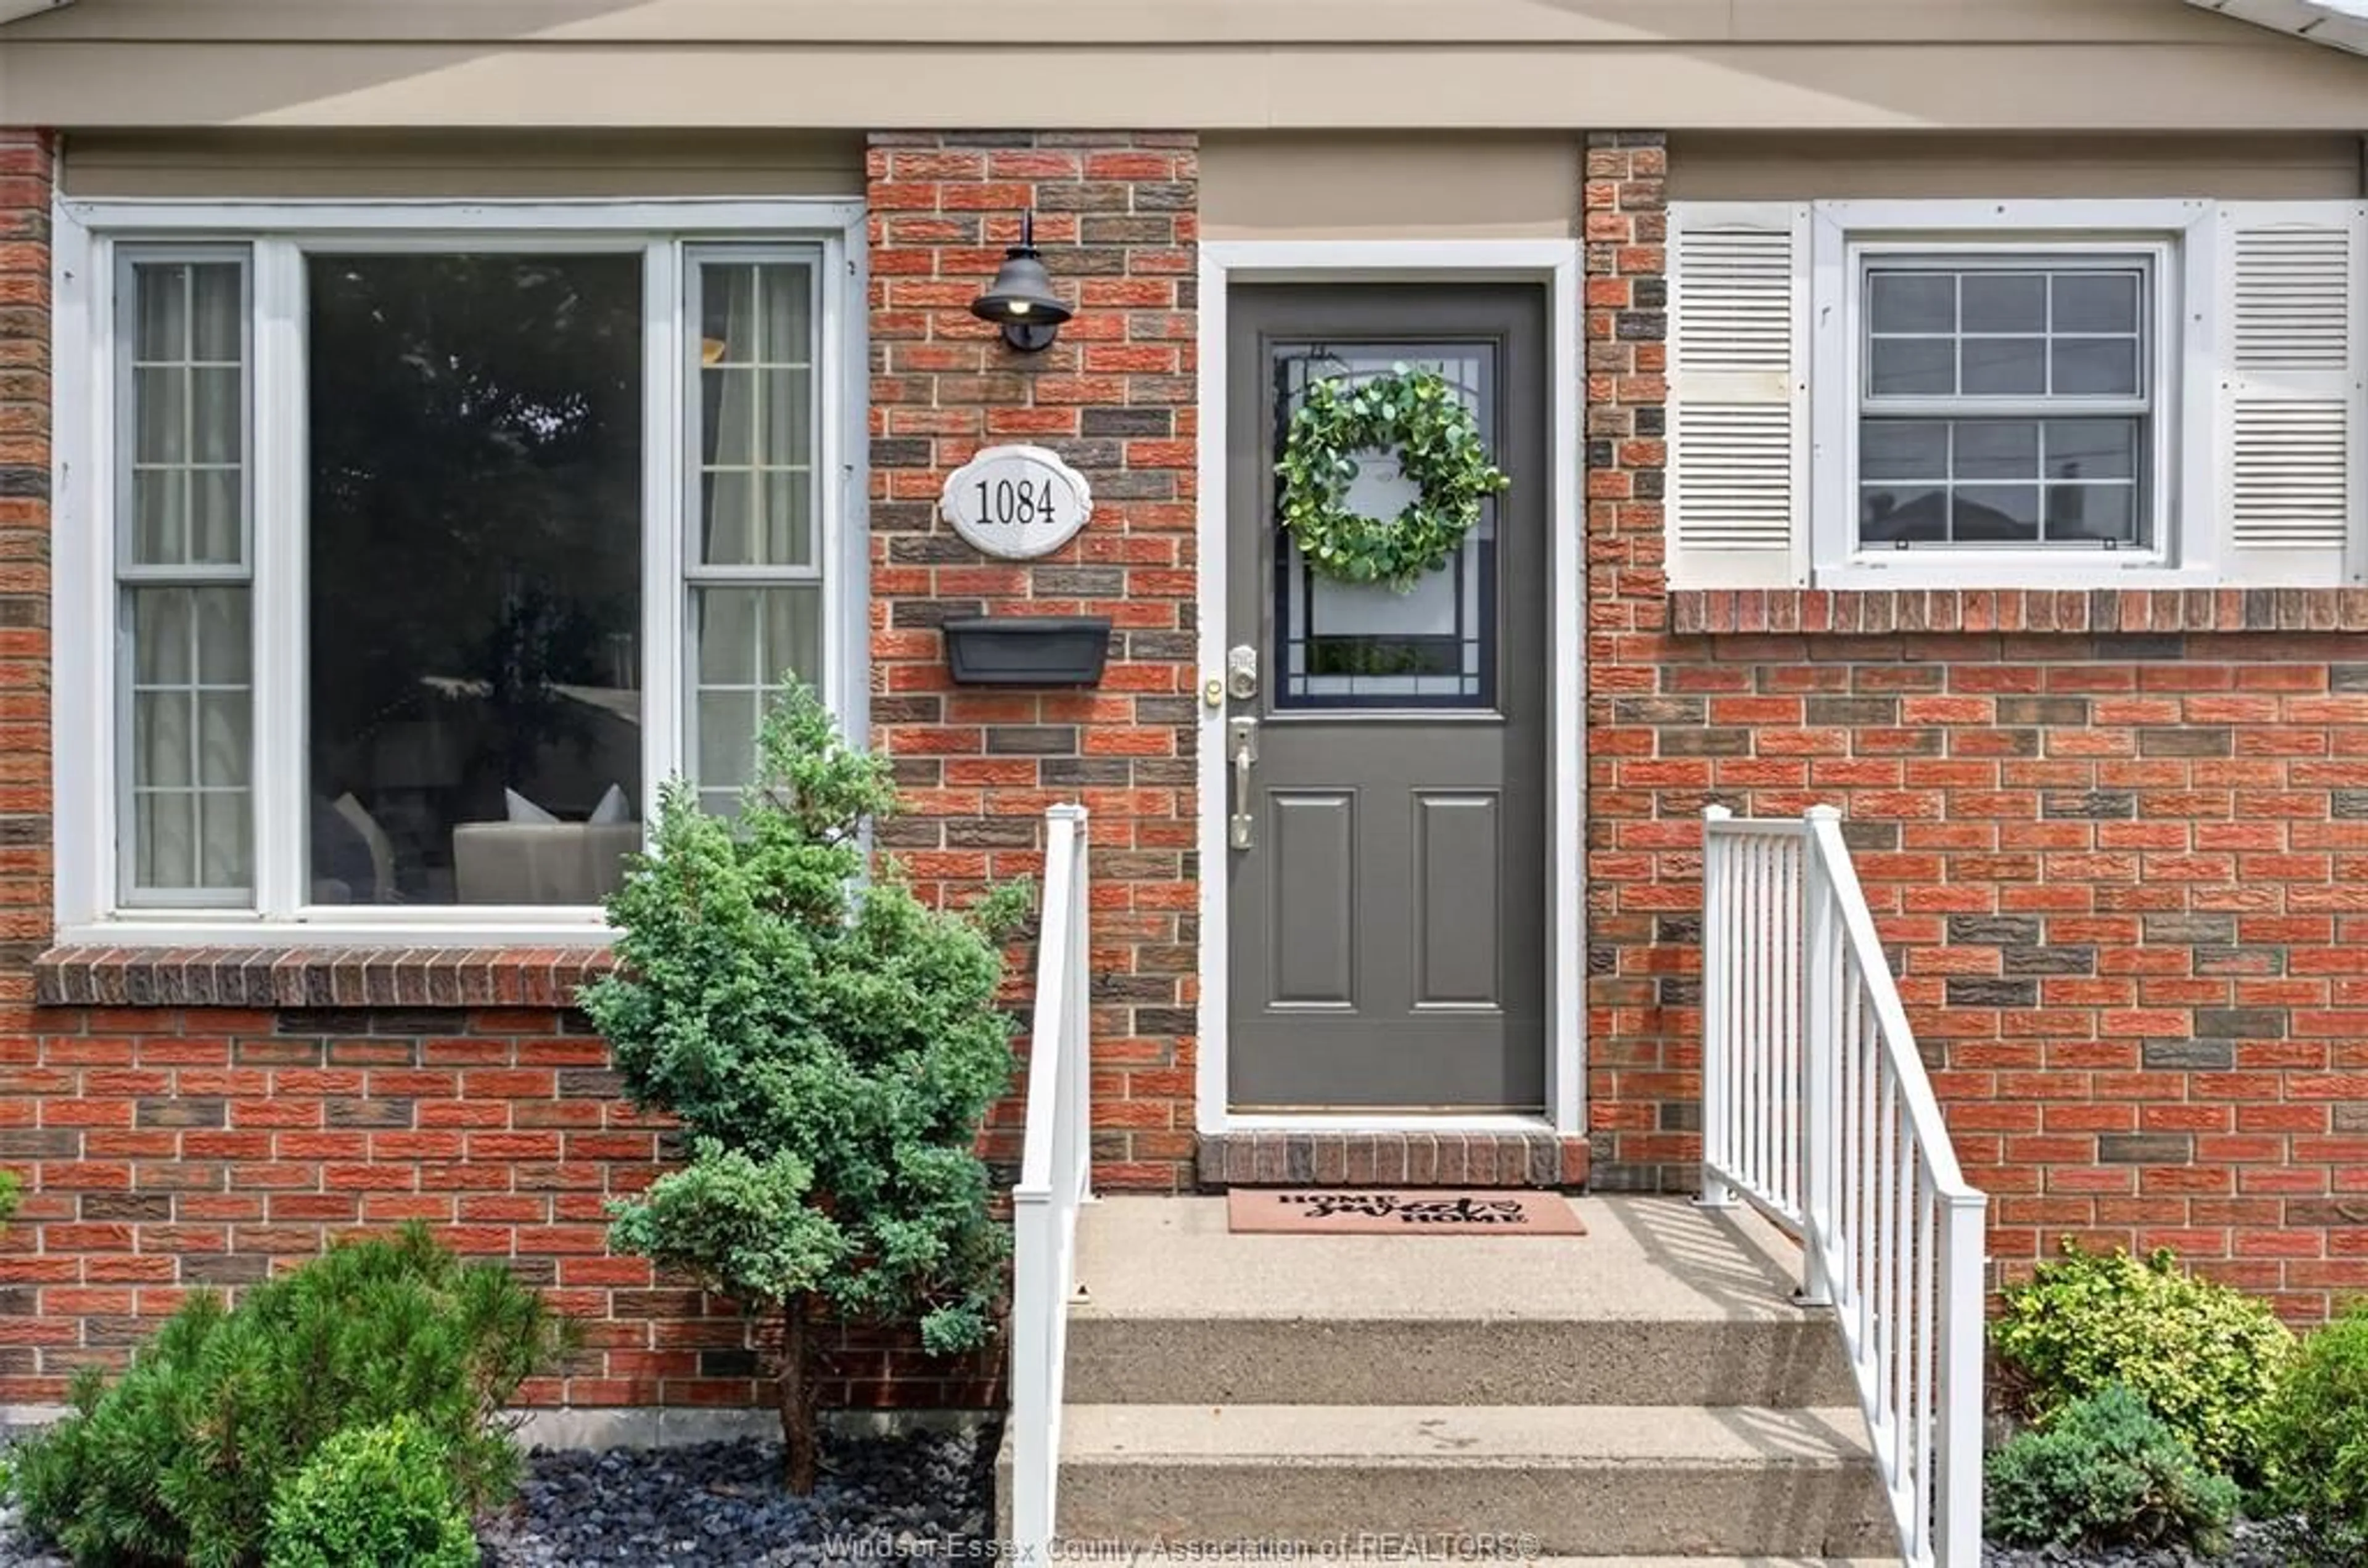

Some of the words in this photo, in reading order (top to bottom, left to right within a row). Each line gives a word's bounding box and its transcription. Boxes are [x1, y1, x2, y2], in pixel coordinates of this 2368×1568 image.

[976, 478, 1056, 523] 1084
[1279, 1194, 1400, 1204] HOME
[1400, 1213, 1529, 1224] HOME
